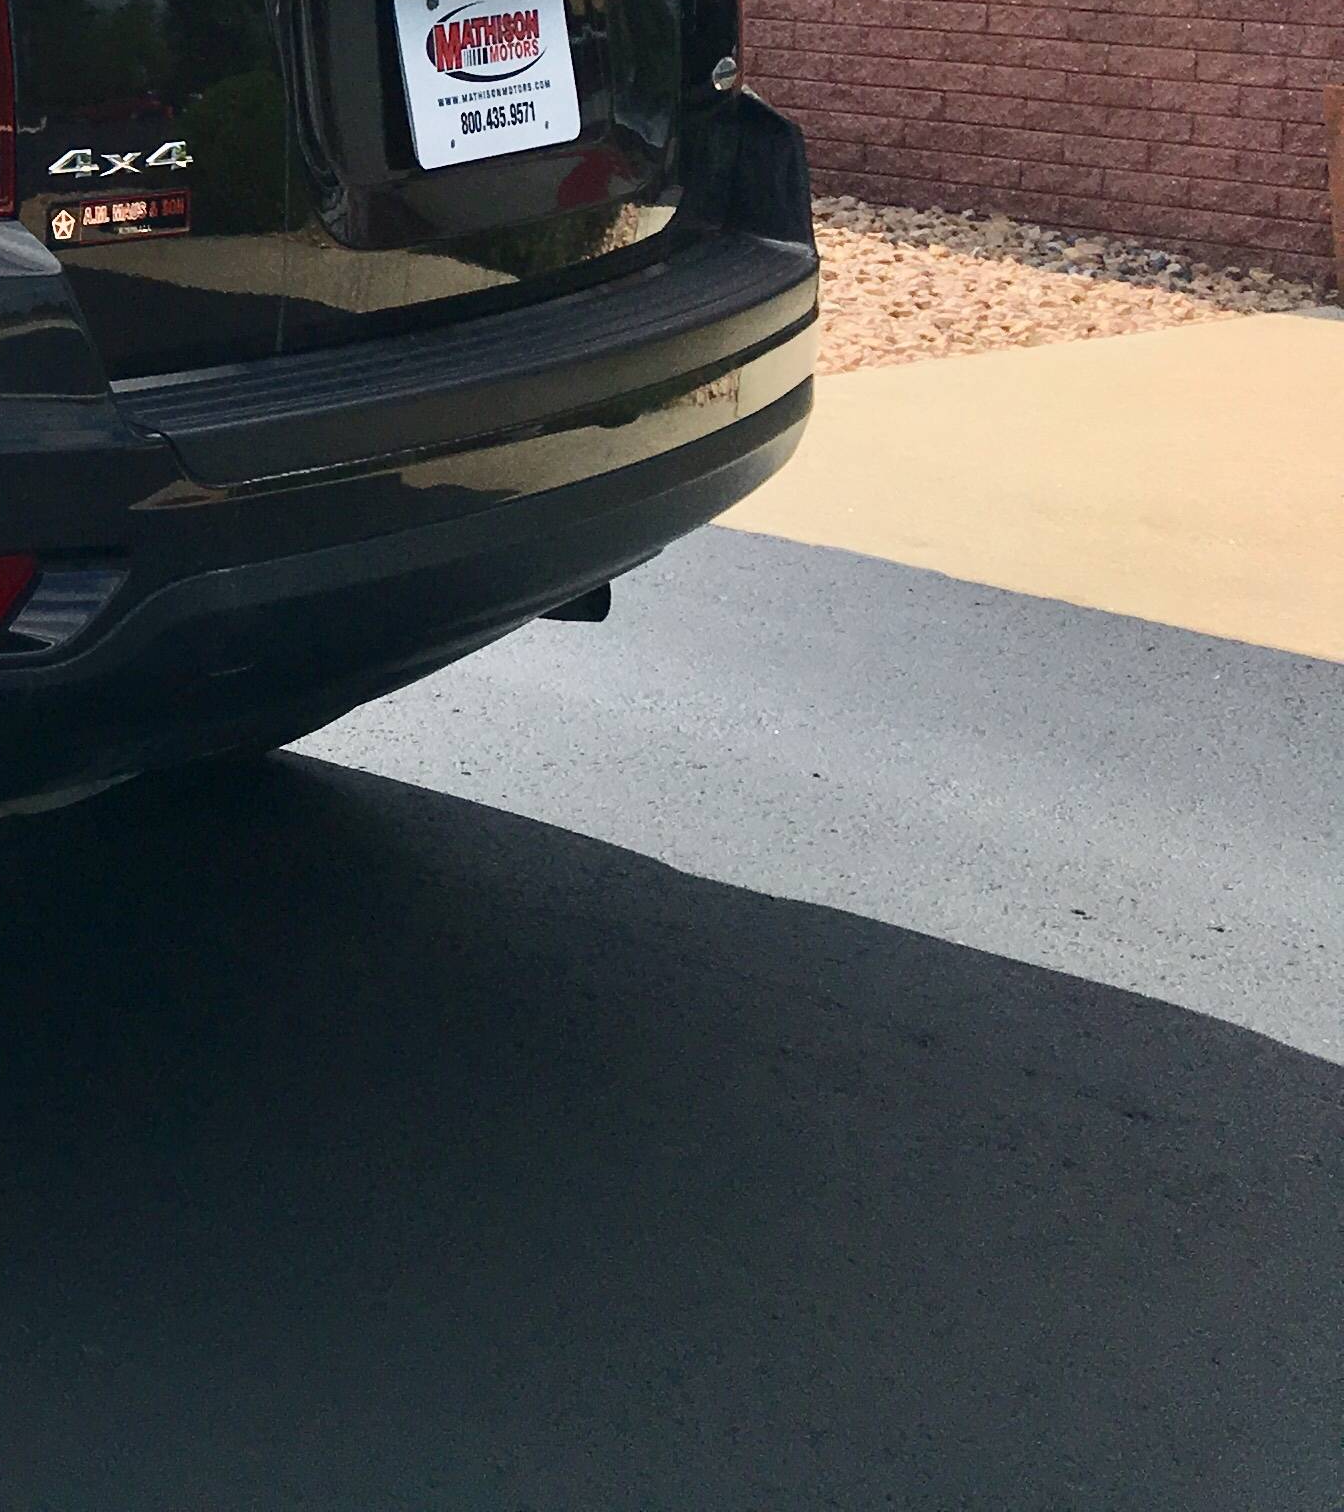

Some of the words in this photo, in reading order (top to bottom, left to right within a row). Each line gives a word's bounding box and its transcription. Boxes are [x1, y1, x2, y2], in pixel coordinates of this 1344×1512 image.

[433, 9, 540, 73] MATHISON
[489, 39, 539, 64] MOTORS
[438, 79, 551, 107] WWW.MATHISONMOTORS.COM
[461, 101, 536, 135] 800.435.9571
[48, 140, 194, 178] 4x4
